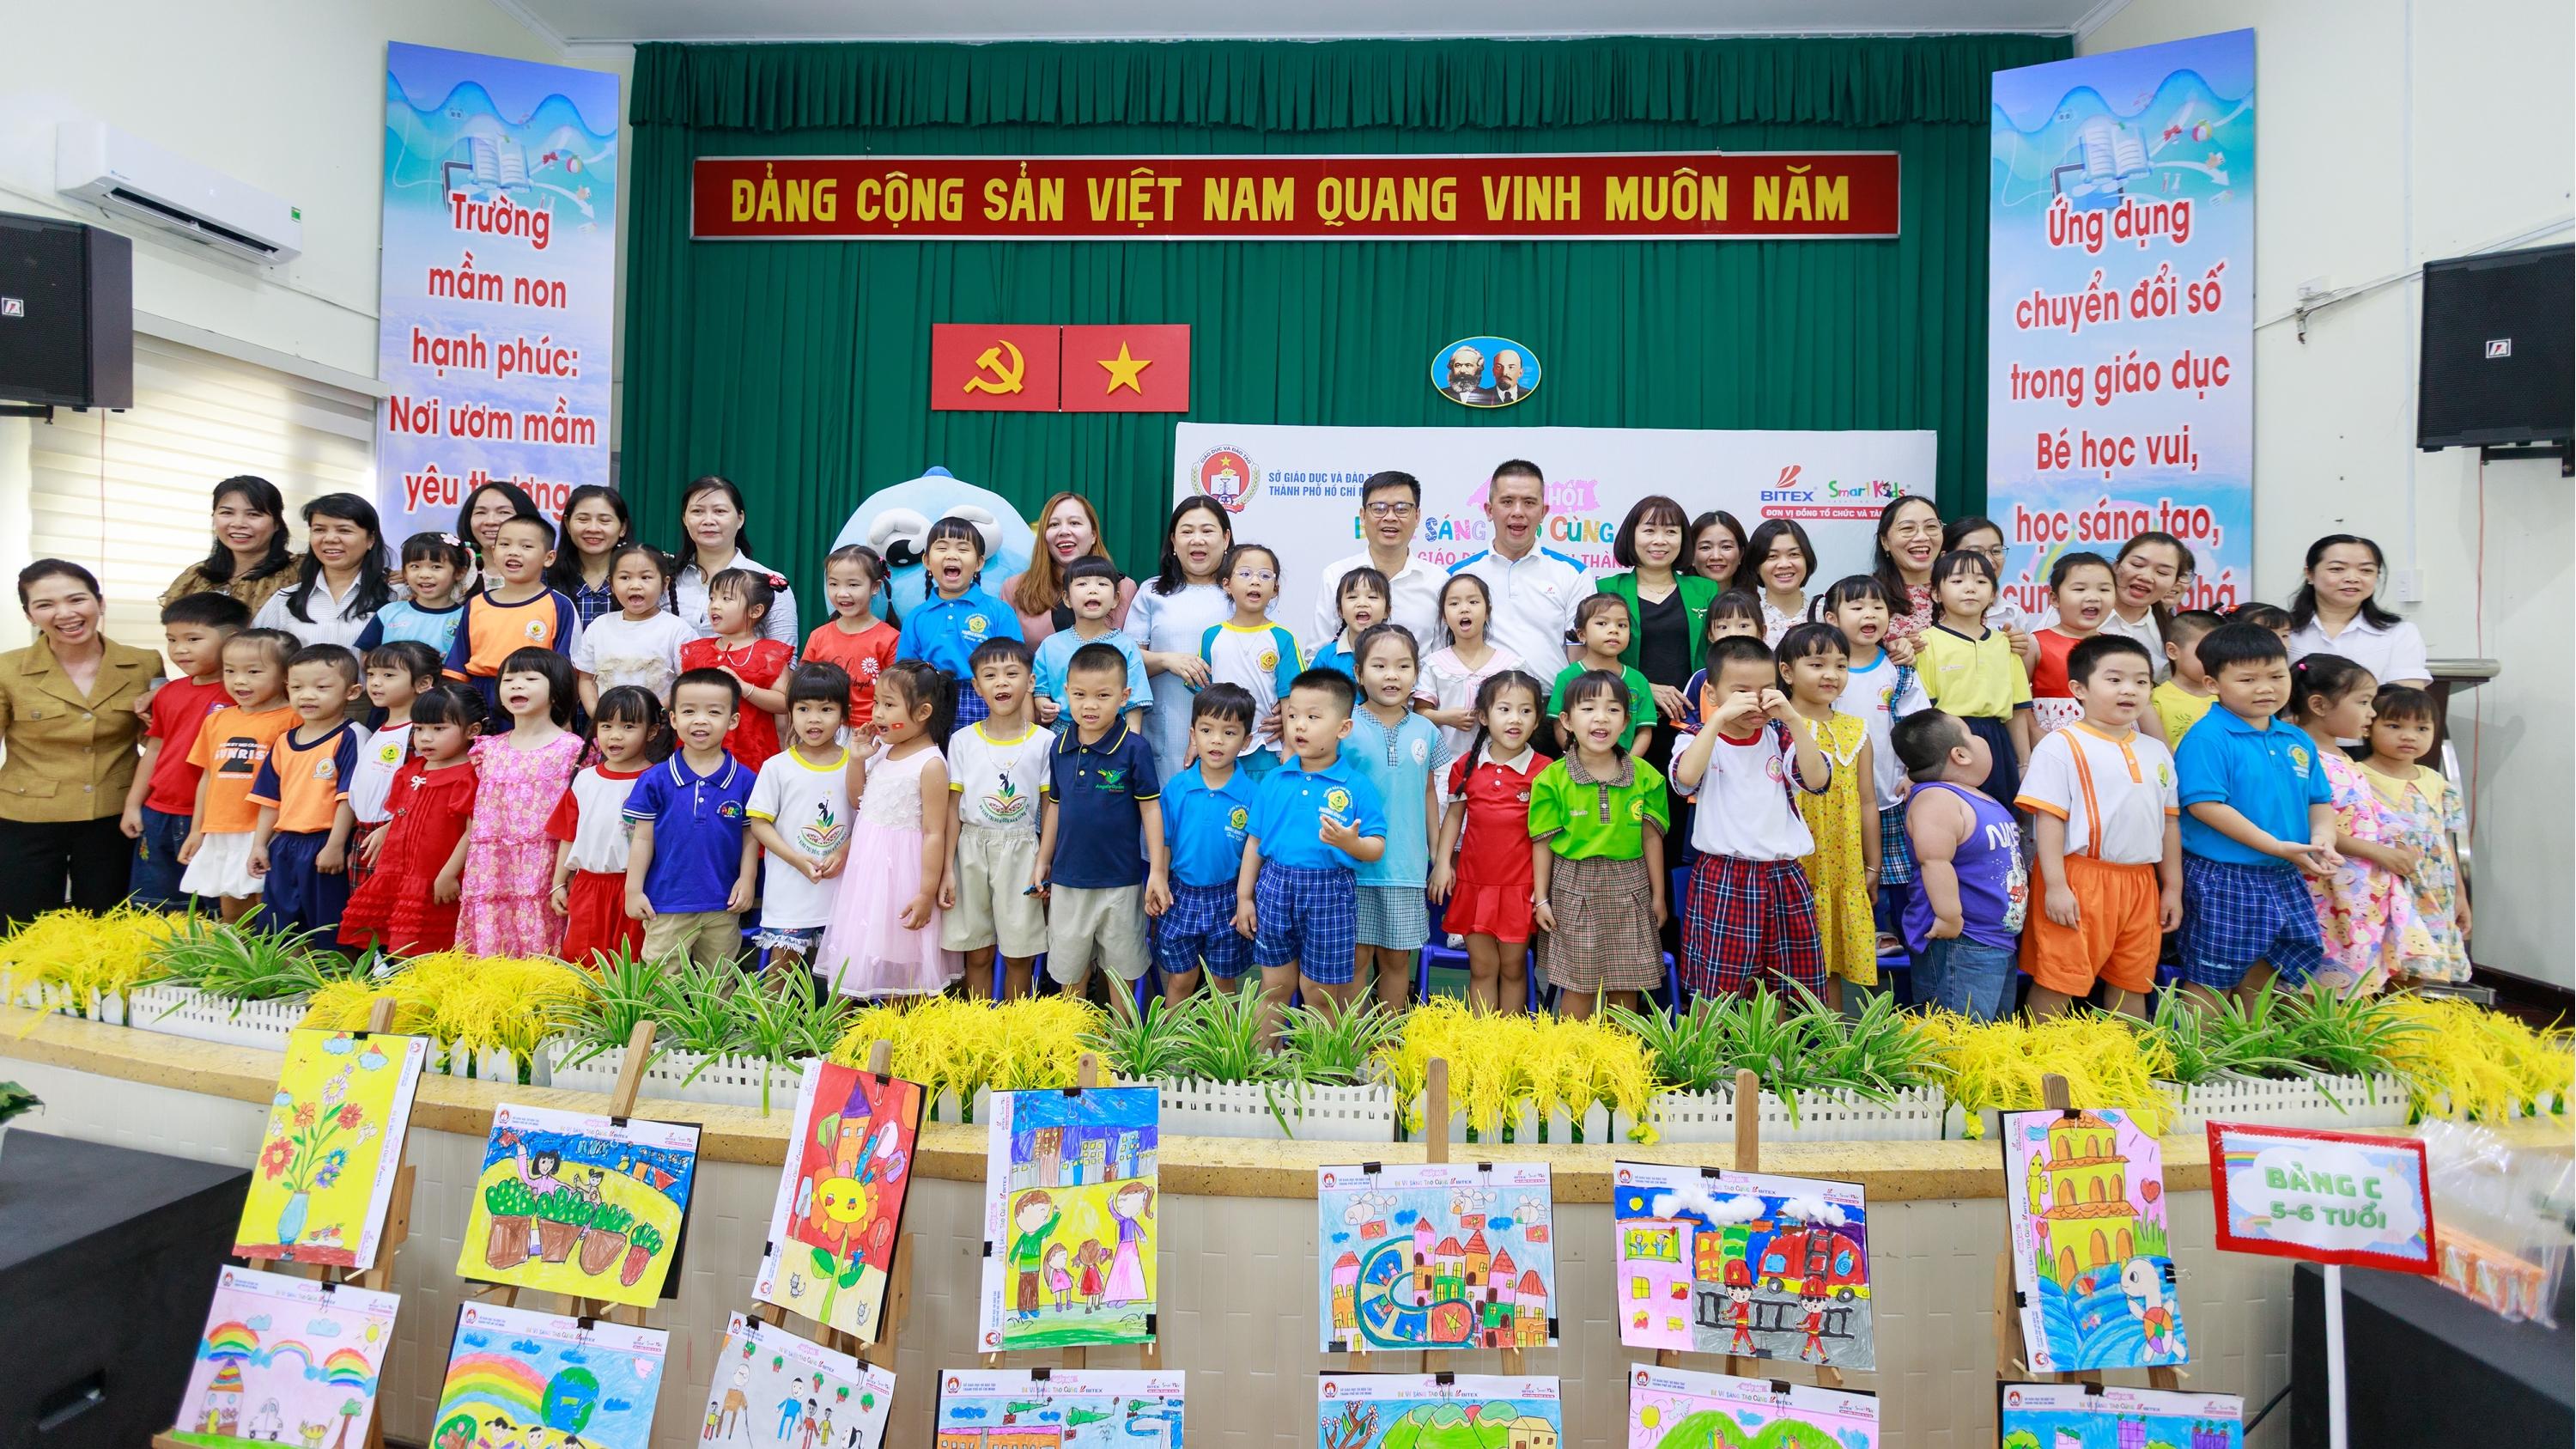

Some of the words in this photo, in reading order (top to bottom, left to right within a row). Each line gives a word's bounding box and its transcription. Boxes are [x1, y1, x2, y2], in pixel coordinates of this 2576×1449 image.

[732, 161, 837, 222] ĐẢNG
[857, 170, 963, 228] CỘNG
[983, 161, 1064, 222] SẢN
[1087, 167, 1182, 228] VIỆT
[1204, 177, 1294, 222] NAM
[1317, 177, 1456, 227] QUANG
[1482, 176, 1581, 221] VINH
[1606, 167, 1728, 222] MUÔN
[1753, 164, 1850, 222] NĂM
[452, 192, 550, 250] Trường
[2049, 197, 2103, 253] Ứng
[2114, 199, 2190, 247] dụng
[428, 251, 503, 302] mầm
[513, 277, 567, 308] non
[2016, 270, 2119, 333] chuyển
[2130, 264, 2177, 320] đổi
[2187, 261, 2226, 314] số
[412, 327, 486, 376] hạnh
[497, 335, 578, 379] phúc:
[2011, 363, 2084, 408] trong
[2094, 350, 2160, 406] giáo
[2172, 350, 2230, 399] dục
[389, 395, 439, 435] Nơi
[449, 404, 513, 439] ươm
[523, 396, 596, 445] mầm
[2037, 427, 2071, 470] Bé
[2081, 430, 2136, 478] học
[2146, 425, 2197, 471] vui,
[405, 465, 459, 511] yêu
[1268, 469, 1281, 483] SỞ
[1285, 471, 1305, 483] GIÁO
[1331, 470, 1343, 483] VÀ
[1346, 471, 1364, 484] ĐÀO
[1269, 483, 1299, 496] THÀNH
[1303, 482, 1321, 496] PHỐ
[1324, 483, 1337, 496] HỒ
[1340, 483, 1357, 496] CHÍ
[1761, 490, 1814, 502] BITEX
[1828, 480, 1870, 498] Smart
[1548, 483, 1585, 512] HỘI
[1786, 508, 1794, 518] VỊ
[1795, 508, 1818, 517] ĐỒNG
[1820, 508, 1831, 517] TỔ
[1832, 508, 1855, 517] CHỨC
[1856, 508, 1868, 517] VÀ
[1425, 514, 1485, 543] SÁNG
[1549, 515, 1614, 544] CÙNG
[2016, 505, 2069, 553] học
[2078, 498, 2149, 541] sáng
[2002, 573, 2050, 614] cùn
[214, 746, 270, 761] SUNRIS
[1985, 821, 2020, 851] NAS
[2362, 1176, 2383, 1199] C
[2269, 1200, 2314, 1222] 5-6
[2320, 1201, 2386, 1230] TUỔI
